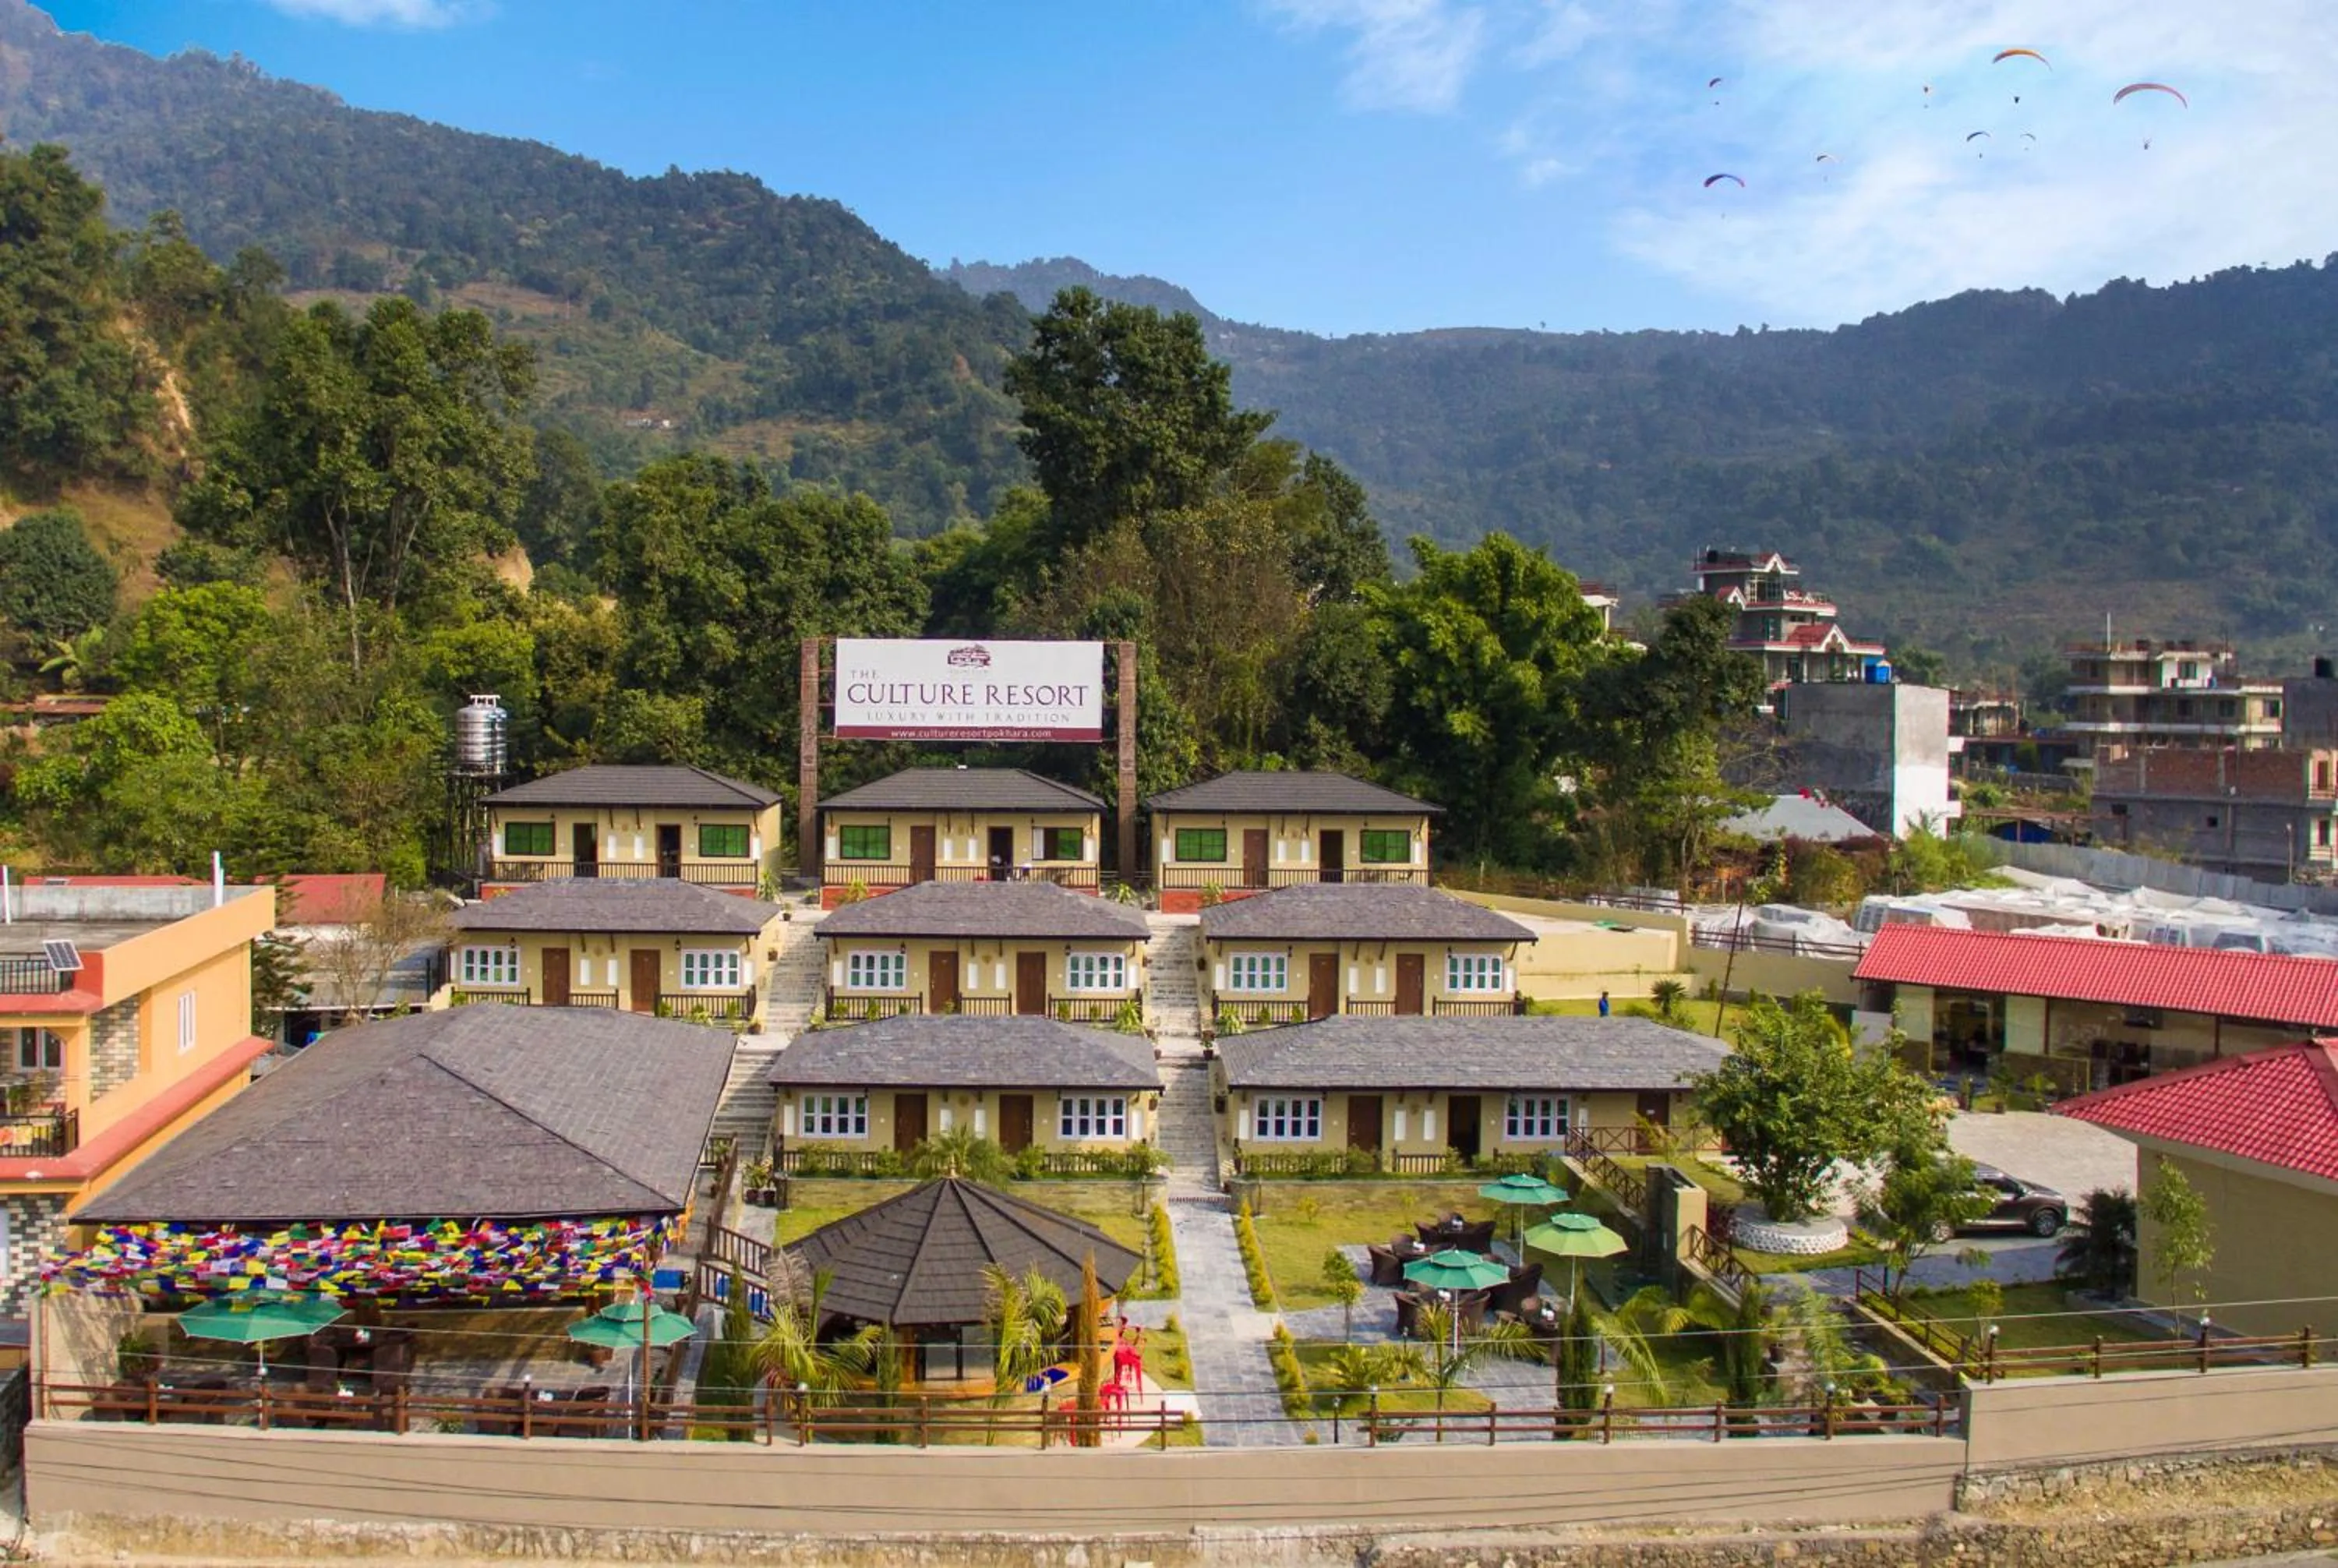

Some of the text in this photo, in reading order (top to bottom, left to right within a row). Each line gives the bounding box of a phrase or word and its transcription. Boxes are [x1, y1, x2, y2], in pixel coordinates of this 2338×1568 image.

[850, 670, 879, 680] THE
[847, 683, 1089, 706] CULTURE RESORT
[867, 712, 1072, 723] LUXURY WITH TRADITION
[891, 729, 1052, 739] www.cultureresortpokhara.com
